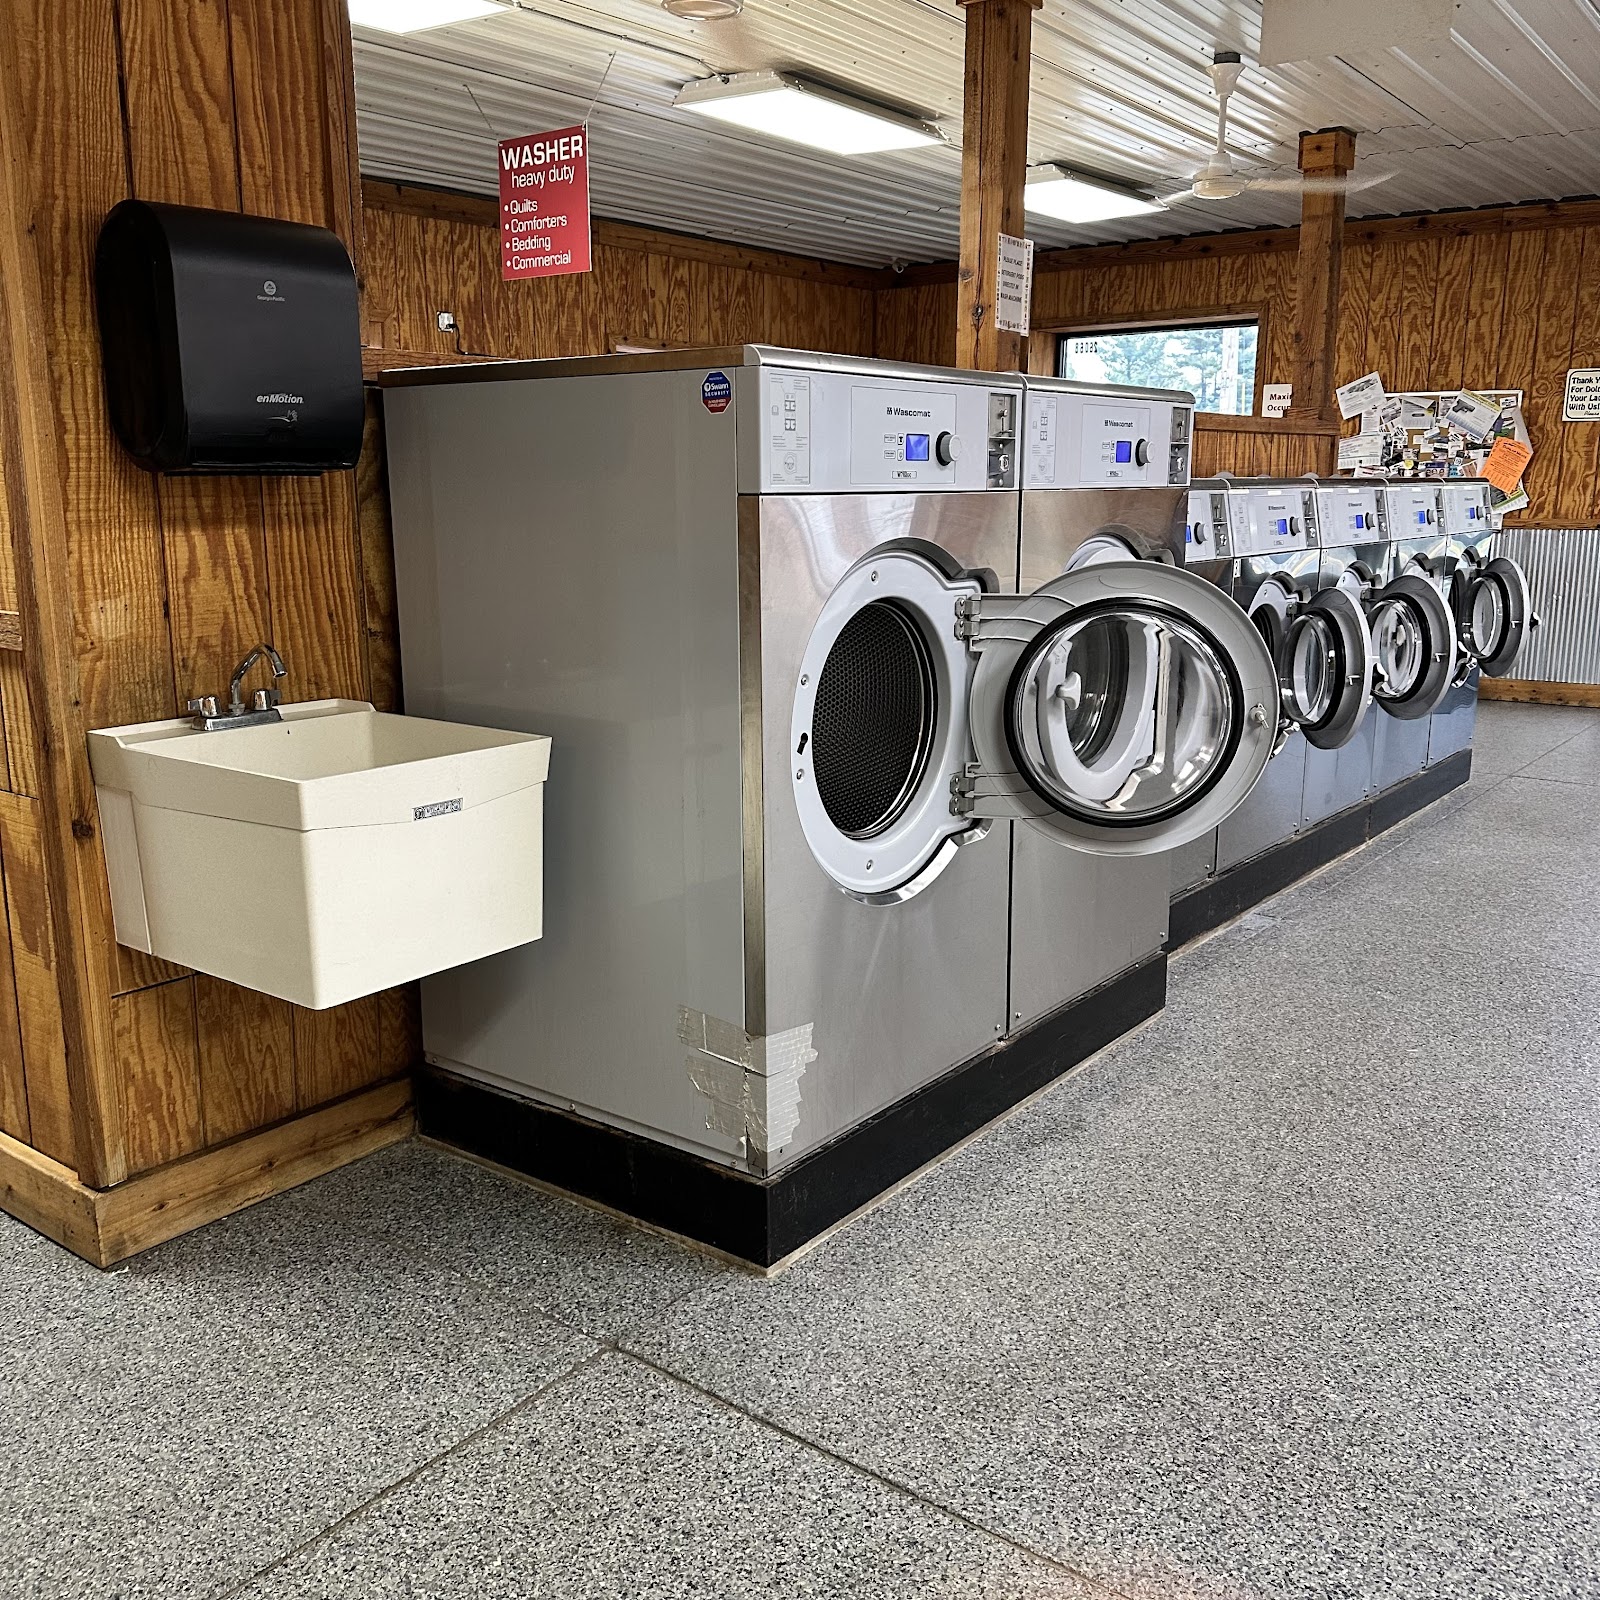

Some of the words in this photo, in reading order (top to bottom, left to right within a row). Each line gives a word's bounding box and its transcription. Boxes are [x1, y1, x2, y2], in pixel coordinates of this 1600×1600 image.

[501, 135, 583, 170] WASHER
[511, 170, 546, 189] heavy
[548, 164, 575, 184] duty
[510, 199, 538, 215] Quilts
[510, 215, 568, 233] Comforters
[511, 235, 551, 252] Bedding
[512, 250, 571, 270] Commercial
[711, 383, 729, 391] Swann
[256, 393, 303, 404] enMotion
[893, 407, 931, 417] Wascomat
[1108, 420, 1134, 428] Wascomat
